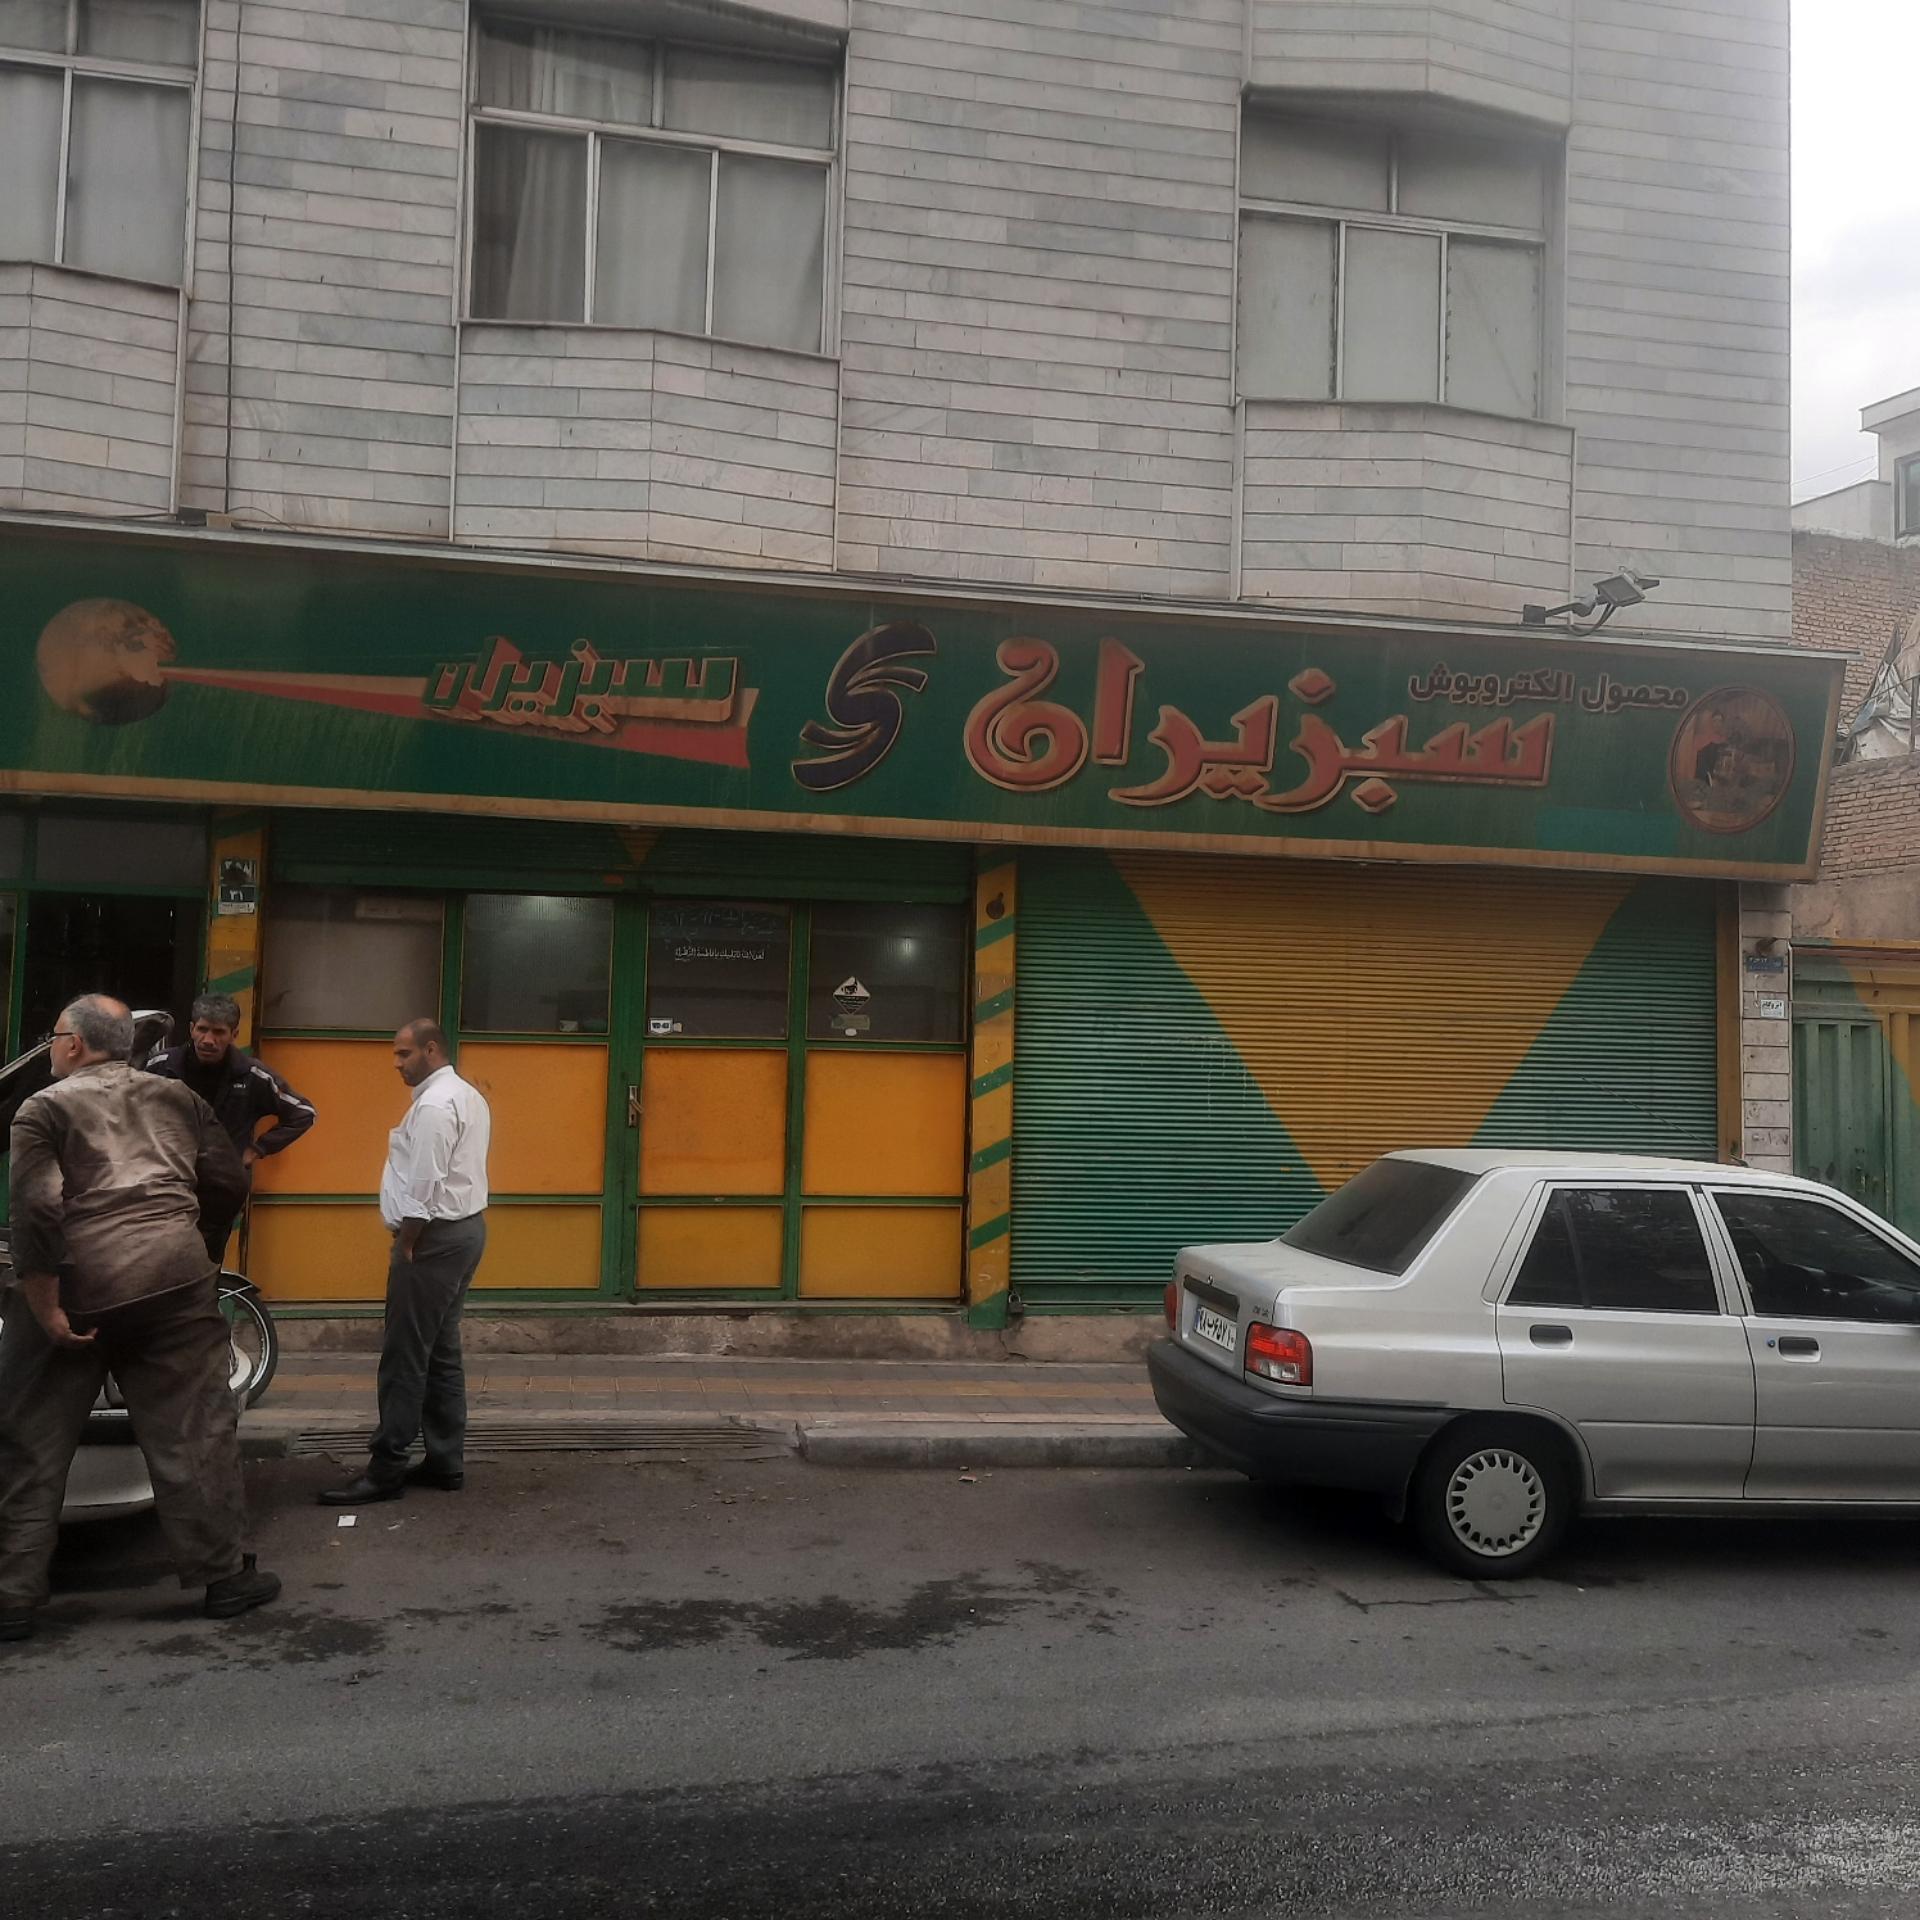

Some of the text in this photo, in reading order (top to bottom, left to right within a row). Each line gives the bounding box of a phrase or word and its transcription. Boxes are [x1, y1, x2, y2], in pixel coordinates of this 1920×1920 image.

[422, 634, 739, 734] سبزیران
[963, 637, 1555, 814] سبزیران
[1580, 673, 1690, 713] محصول
